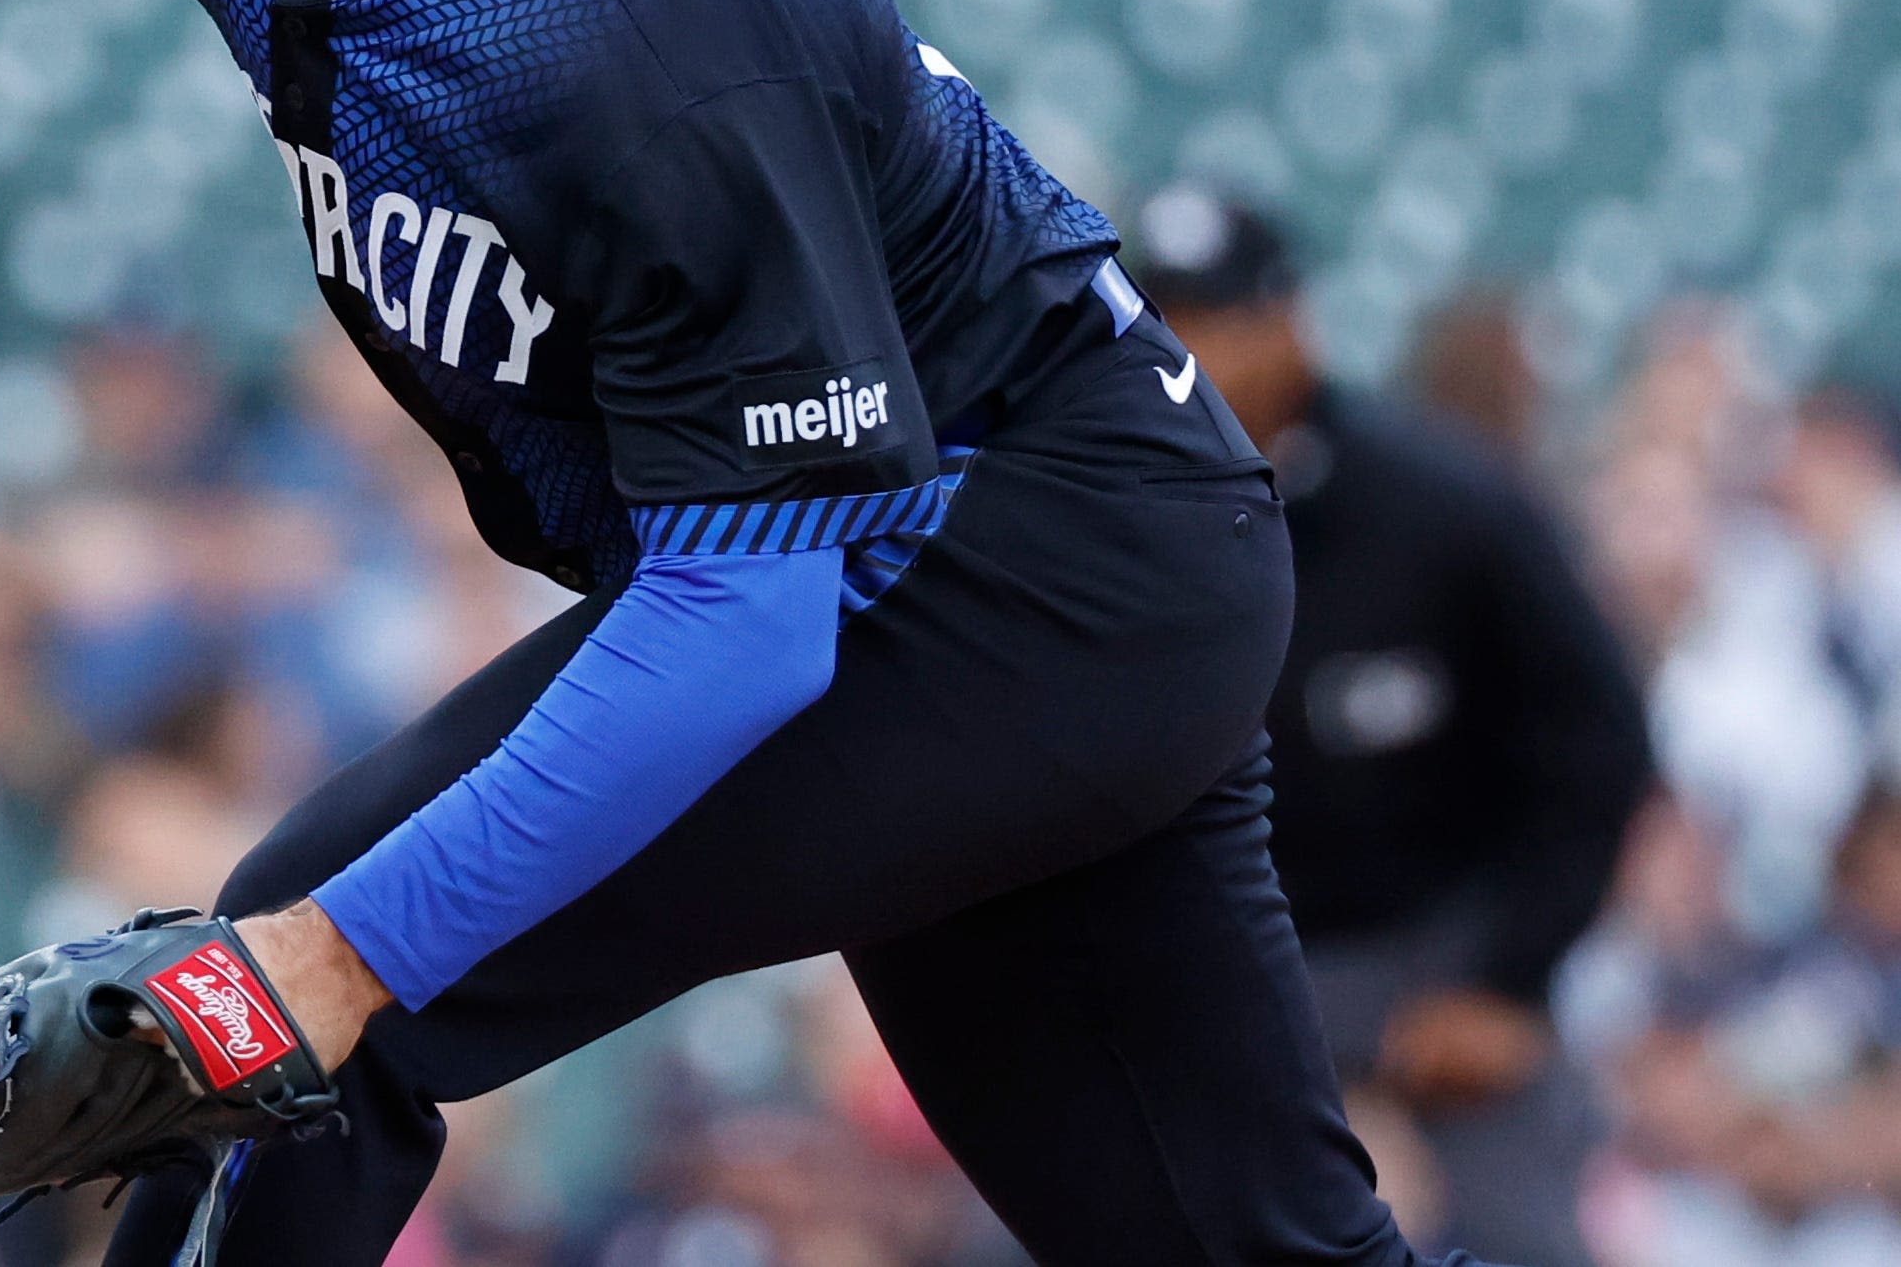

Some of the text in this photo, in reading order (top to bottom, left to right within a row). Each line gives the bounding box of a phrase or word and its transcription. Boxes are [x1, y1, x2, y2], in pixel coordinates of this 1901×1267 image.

[368, 191, 556, 386] CITY
[743, 376, 889, 448] meijer
[175, 972, 265, 1060] Rawlings
